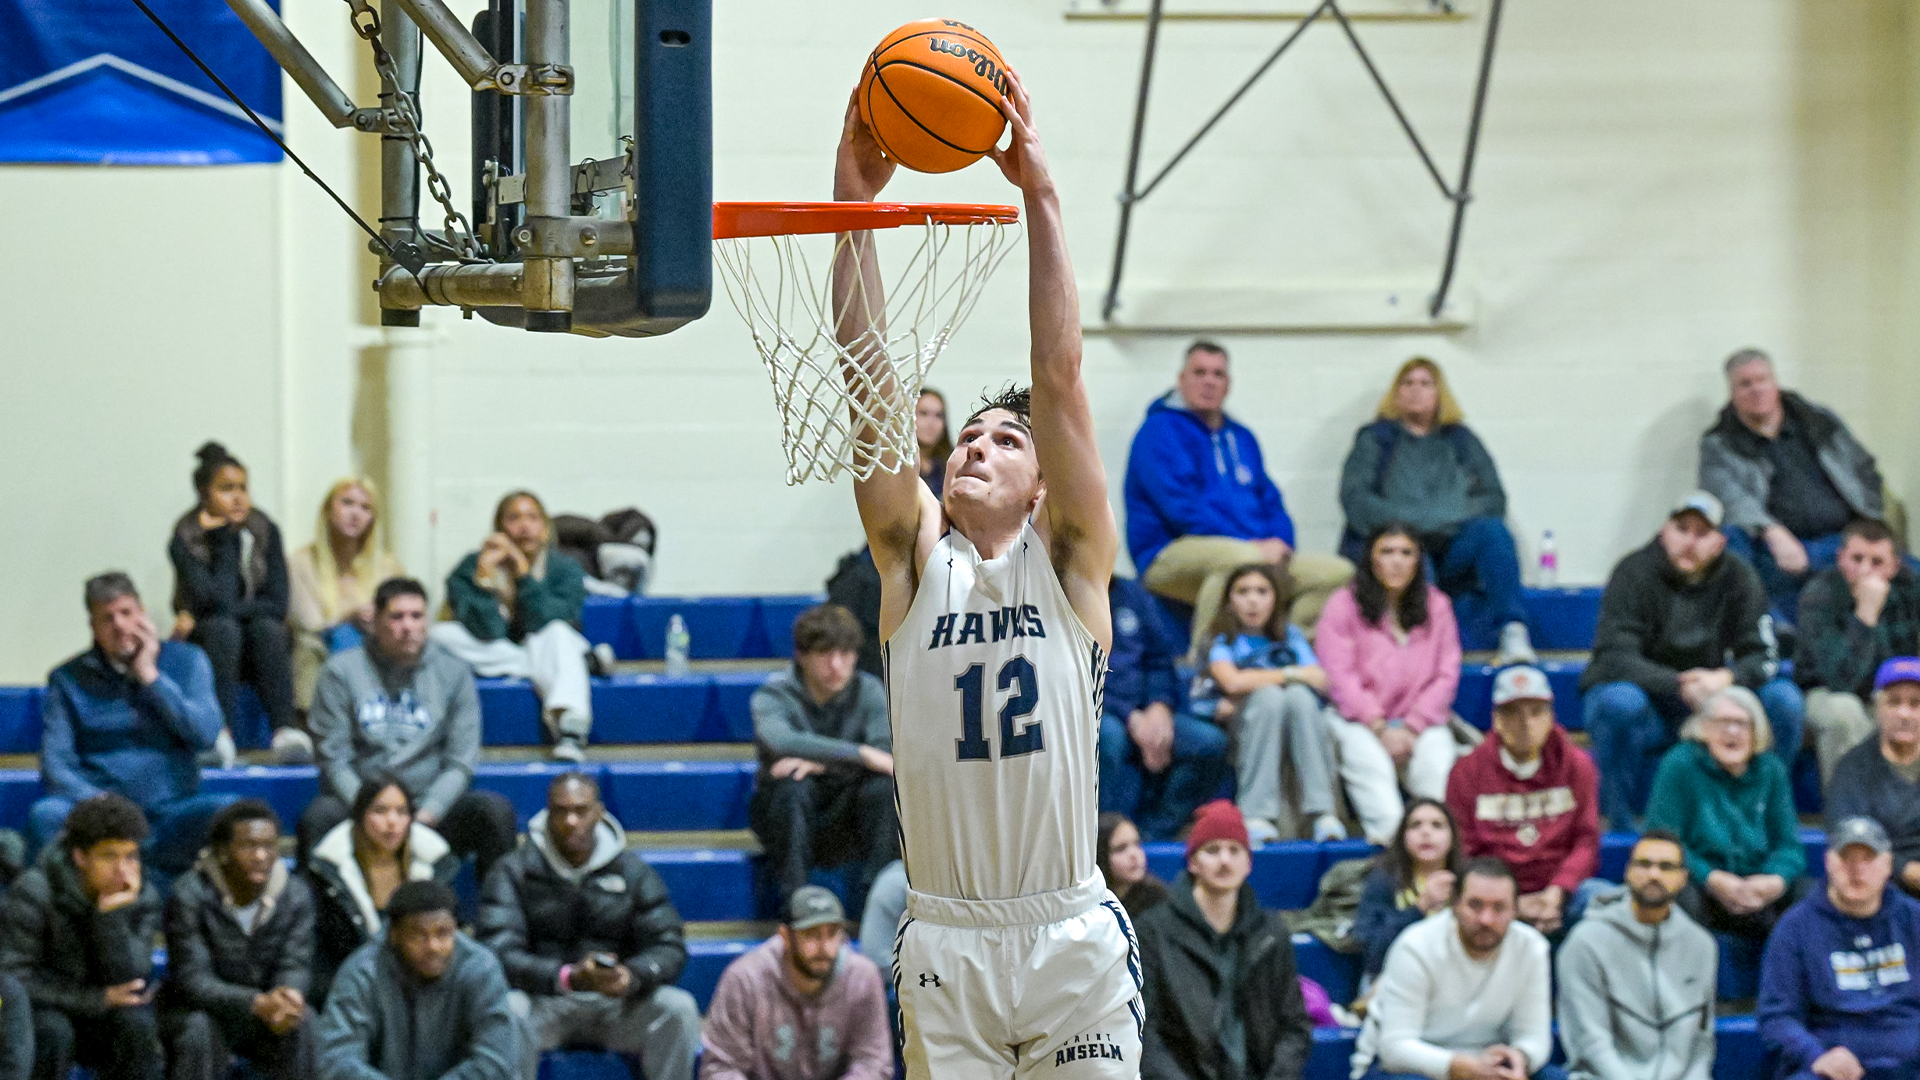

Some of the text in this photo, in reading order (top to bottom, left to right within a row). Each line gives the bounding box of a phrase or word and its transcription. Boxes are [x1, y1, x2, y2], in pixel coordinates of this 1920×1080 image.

[928, 604, 1046, 650] HAWKS
[953, 653, 1046, 762] 12
[1055, 1043, 1124, 1067] ANSELM
